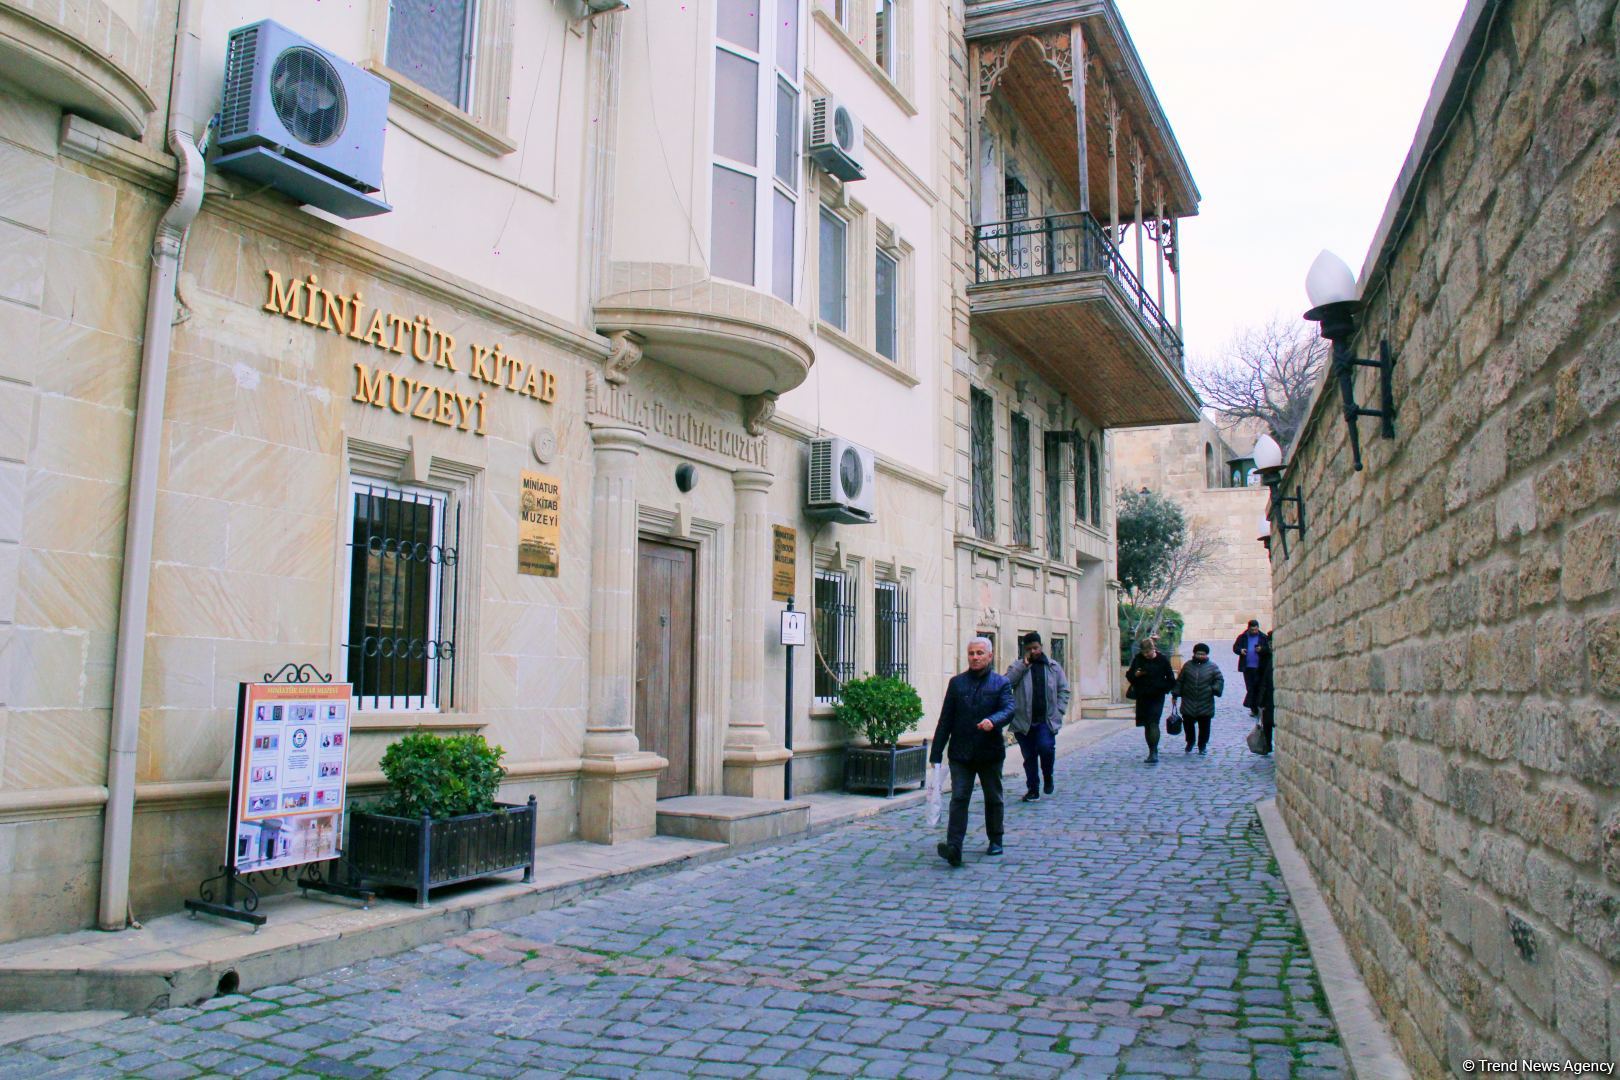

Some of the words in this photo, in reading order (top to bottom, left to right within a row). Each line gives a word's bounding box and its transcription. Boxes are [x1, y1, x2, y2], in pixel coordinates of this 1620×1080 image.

[264, 269, 460, 373] MİNİATÜR
[469, 343, 558, 404] KİTAB
[352, 362, 488, 436] MUZEYİ
[521, 511, 558, 527] MUZEYİ
[536, 496, 558, 510] KİTAB
